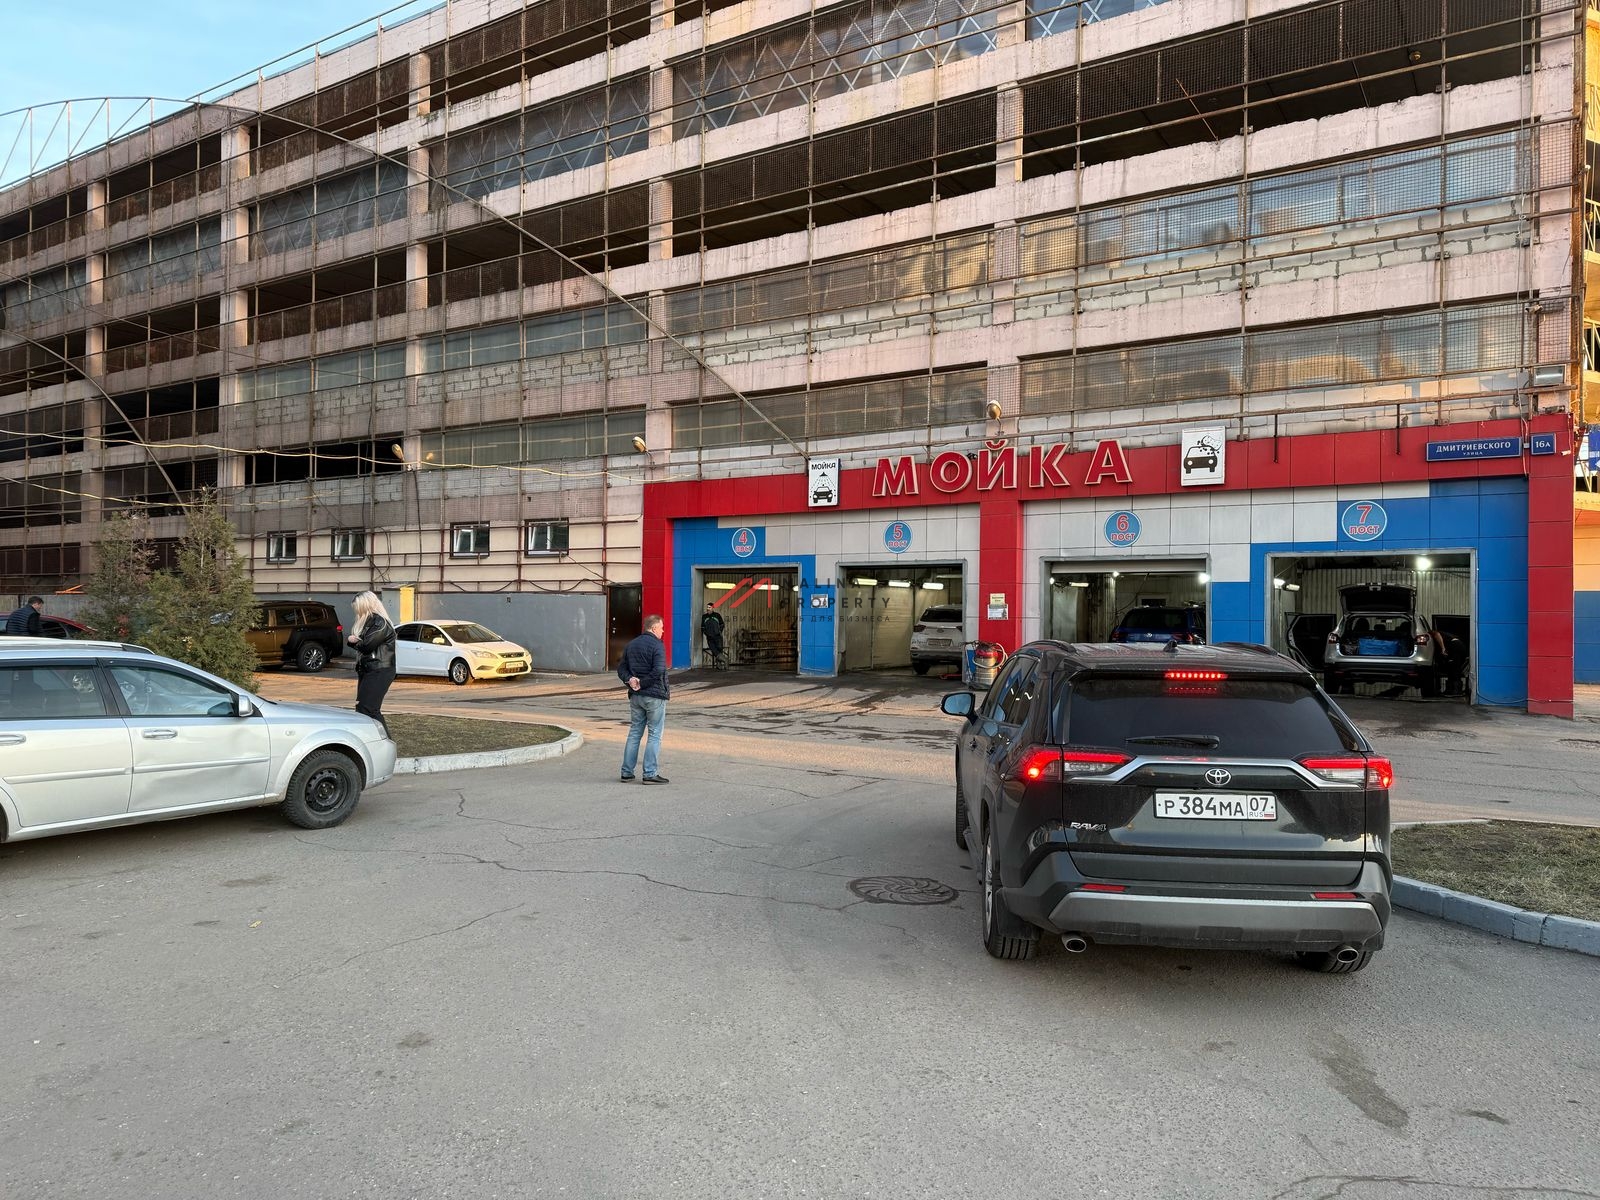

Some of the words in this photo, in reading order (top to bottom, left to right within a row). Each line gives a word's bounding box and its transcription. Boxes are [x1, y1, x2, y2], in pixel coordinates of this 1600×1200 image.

[1436, 441, 1511, 453] ДМИТРИЕВСКОГО
[811, 461, 836, 470] МОЙКА
[872, 439, 1133, 496] МОЙКА
[1357, 505, 1371, 524] 7
[1117, 515, 1129, 532] 6
[738, 530, 748, 545] 4
[893, 524, 903, 540] 5
[1250, 797, 1269, 812] 07
